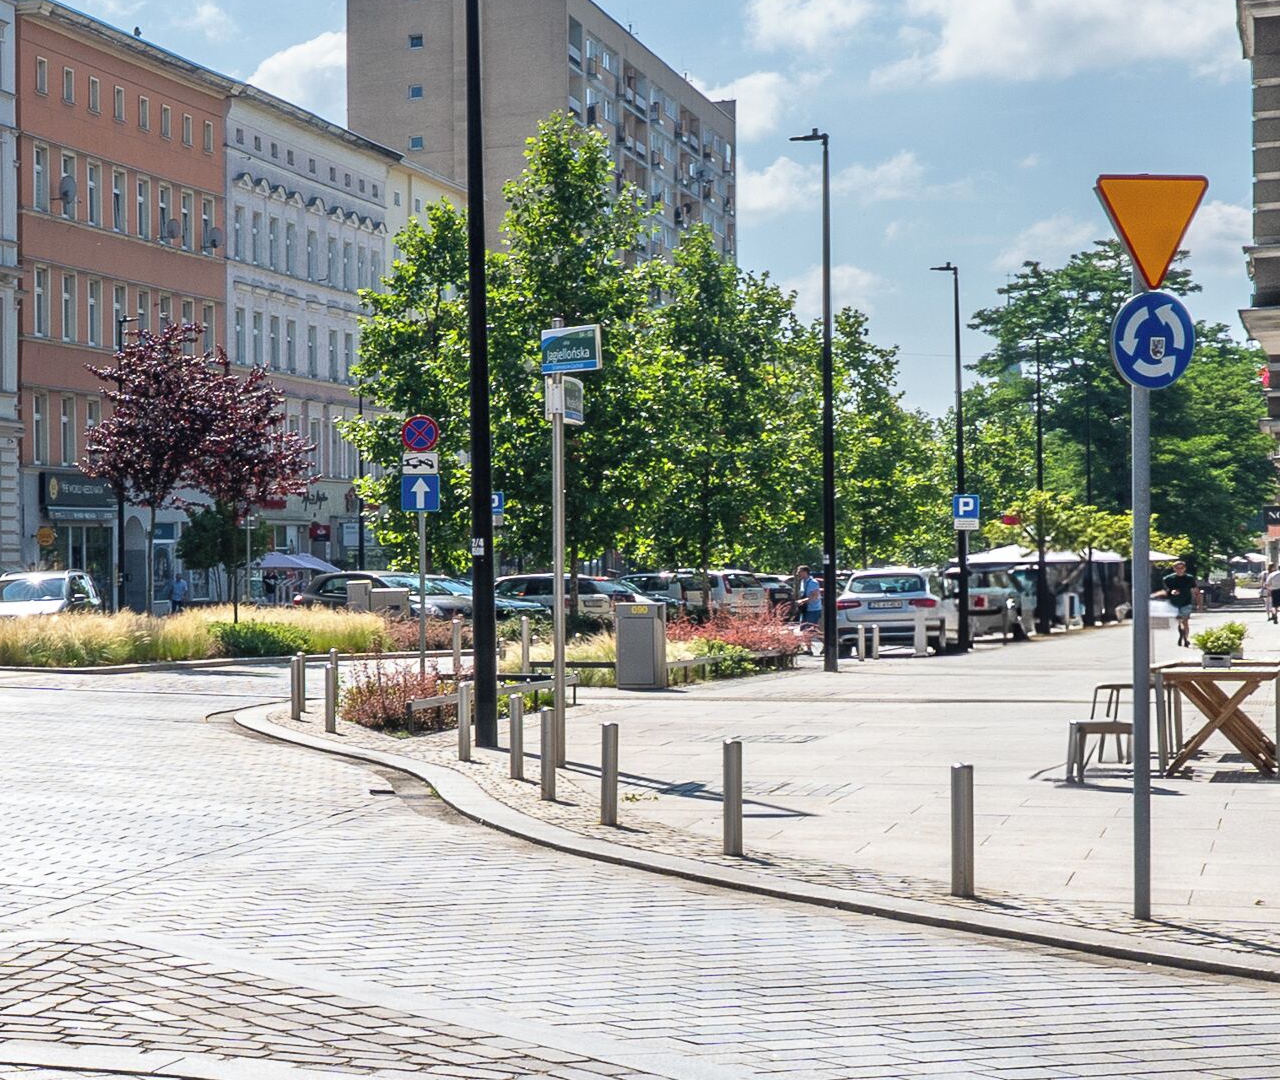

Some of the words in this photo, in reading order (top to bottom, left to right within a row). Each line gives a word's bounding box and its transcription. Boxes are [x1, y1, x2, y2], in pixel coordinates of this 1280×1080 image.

[546, 347, 590, 364] Jagiellońska
[959, 498, 974, 515] P
[631, 605, 648, 614] 090
